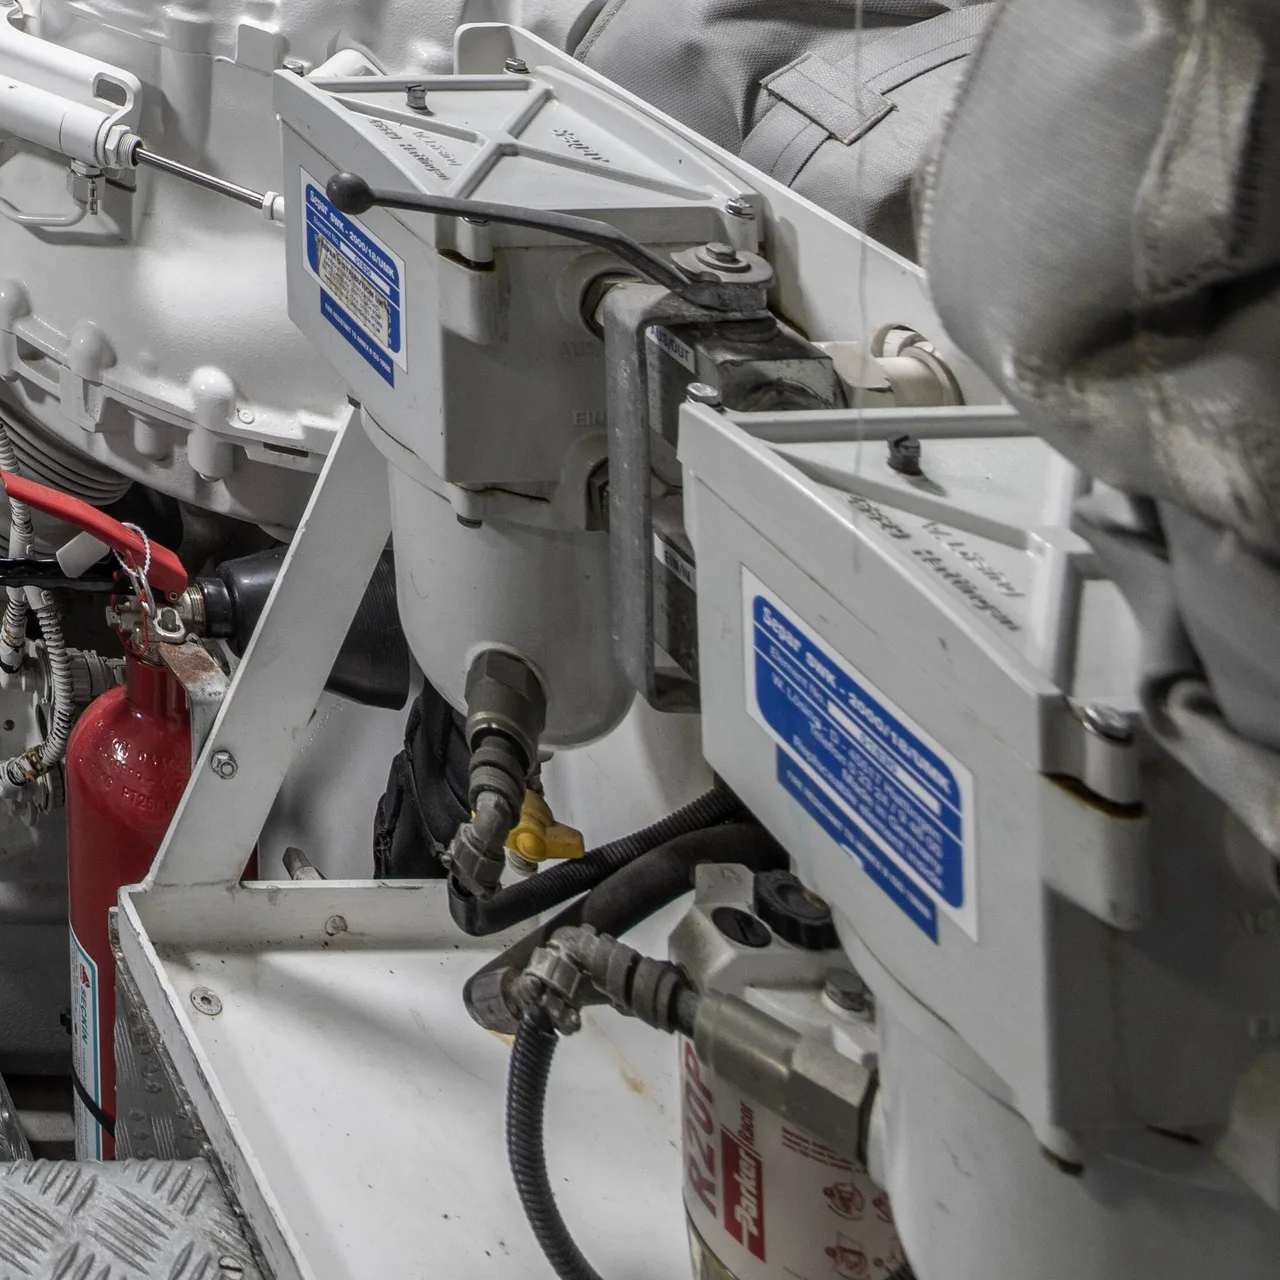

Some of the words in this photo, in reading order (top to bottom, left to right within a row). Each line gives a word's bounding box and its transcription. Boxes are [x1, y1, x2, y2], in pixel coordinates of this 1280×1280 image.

[762, 603, 802, 660] Separ
[684, 1040, 718, 1219] R20P
[733, 1147, 760, 1237] Parker
